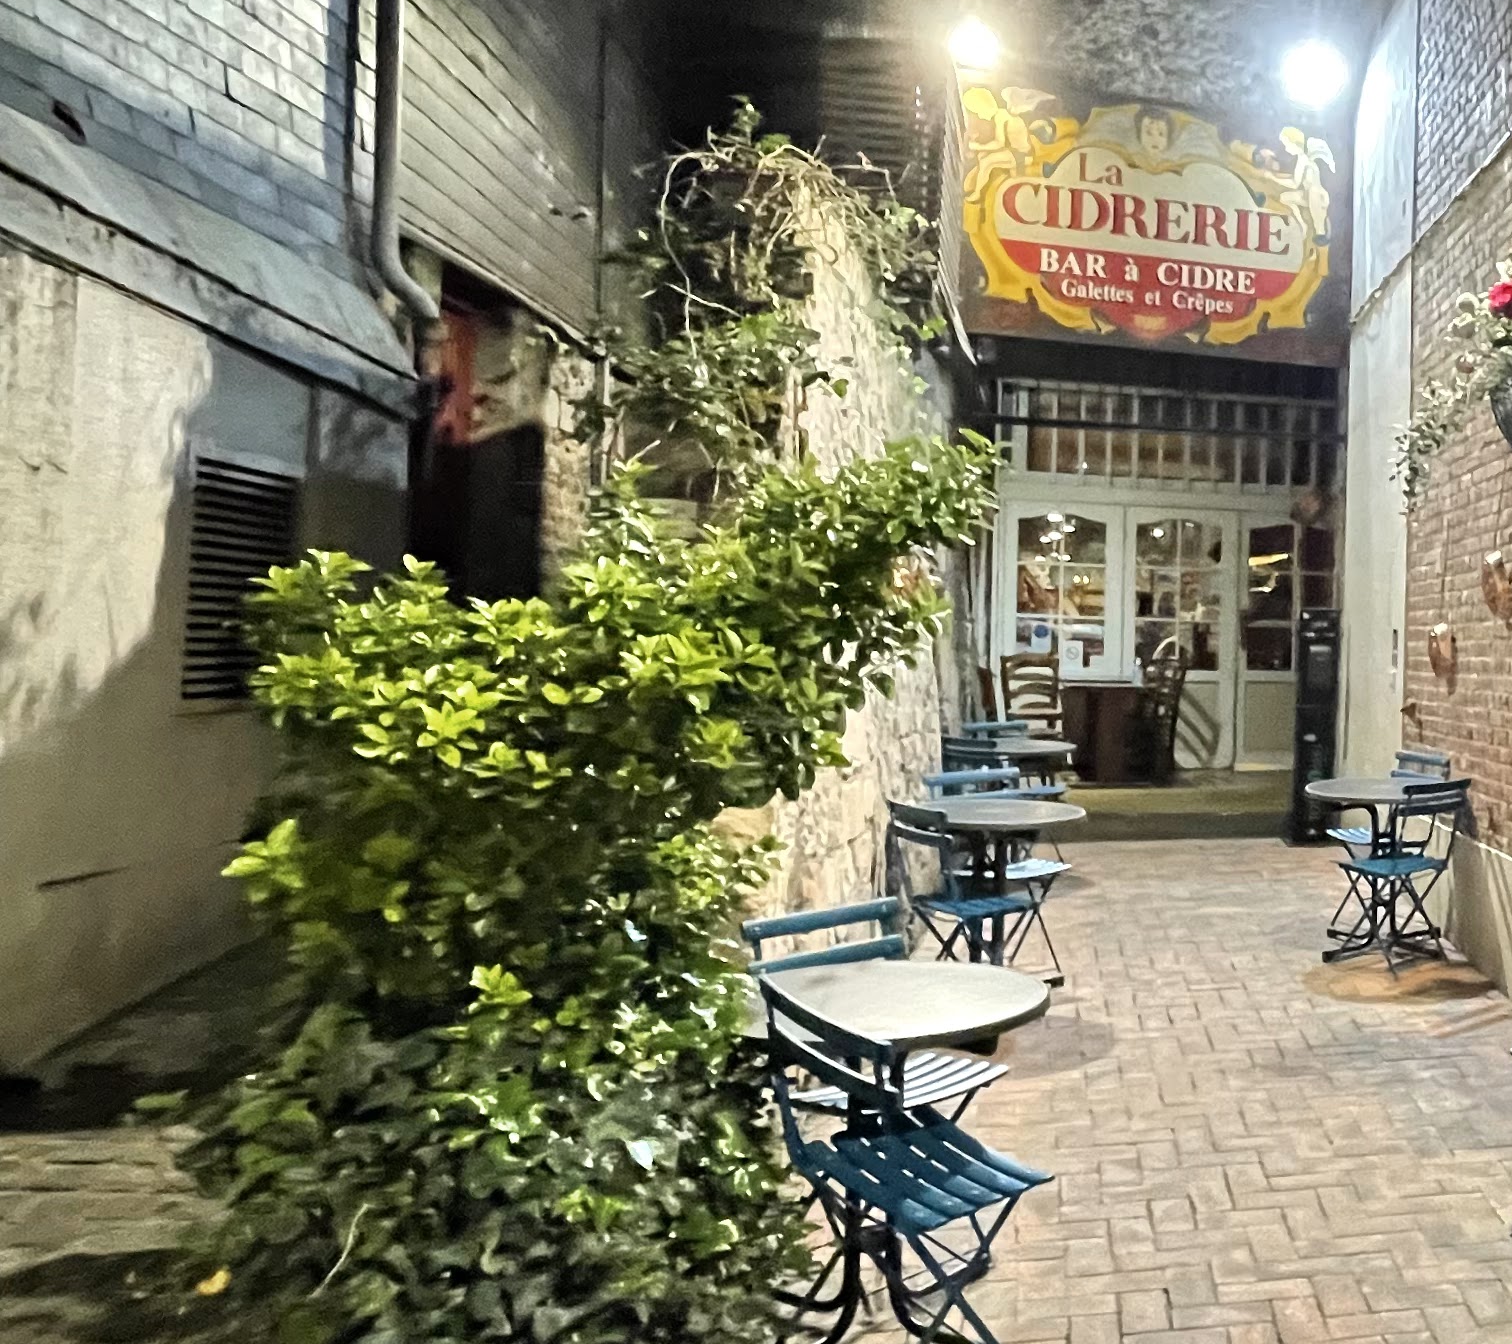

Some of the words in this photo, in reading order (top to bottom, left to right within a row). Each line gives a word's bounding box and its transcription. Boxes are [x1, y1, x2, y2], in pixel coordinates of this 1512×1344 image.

[1079, 152, 1124, 187] La
[1002, 182, 1291, 256] CIDRERIE
[1039, 248, 1107, 279] BAR
[1124, 257, 1140, 282] à
[1156, 262, 1256, 295] CIDRE
[1061, 278, 1134, 303] Galettes
[1144, 289, 1161, 306] et
[1172, 290, 1234, 315] Crêpes
